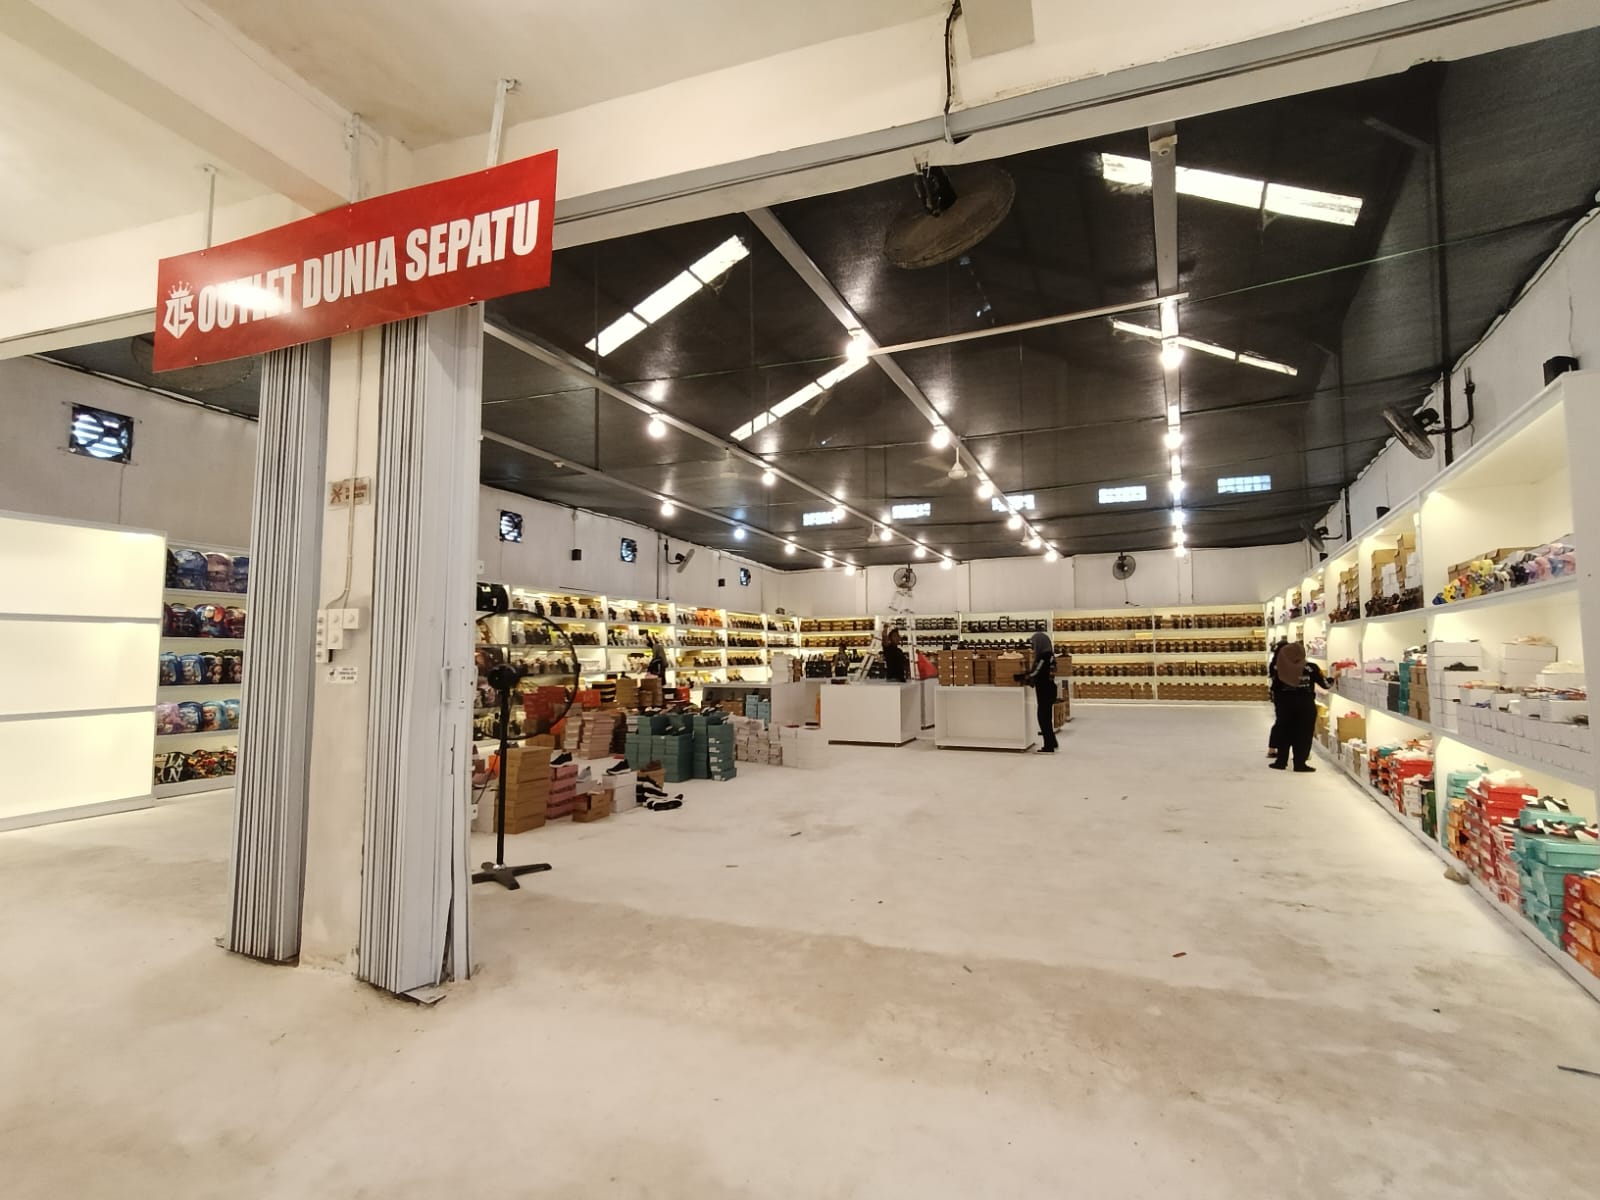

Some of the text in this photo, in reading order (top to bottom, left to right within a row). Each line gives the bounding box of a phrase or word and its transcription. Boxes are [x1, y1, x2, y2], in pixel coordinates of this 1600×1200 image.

[198, 199, 540, 332] OUTLET DUNIA SEPATU
